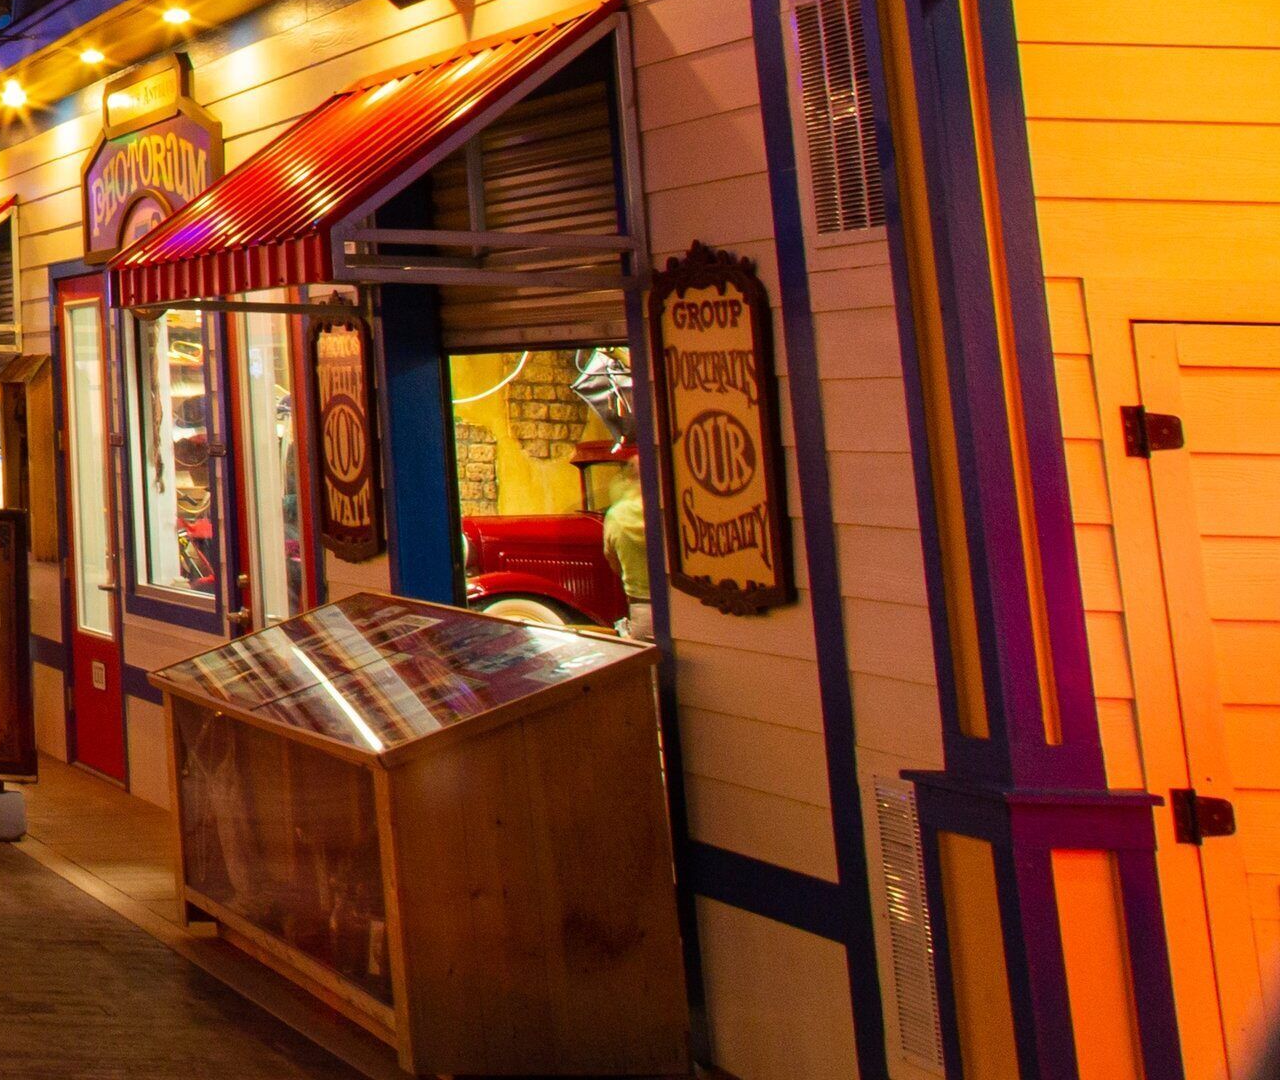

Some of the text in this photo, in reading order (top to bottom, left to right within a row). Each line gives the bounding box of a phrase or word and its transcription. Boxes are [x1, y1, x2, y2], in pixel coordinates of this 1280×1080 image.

[672, 299, 742, 332] GROUP
[664, 344, 758, 444] PORTRAITS
[325, 407, 361, 477] YOU
[690, 415, 753, 492] OUR
[324, 476, 371, 527] WAIT
[682, 487, 772, 570] SPECIALTY
